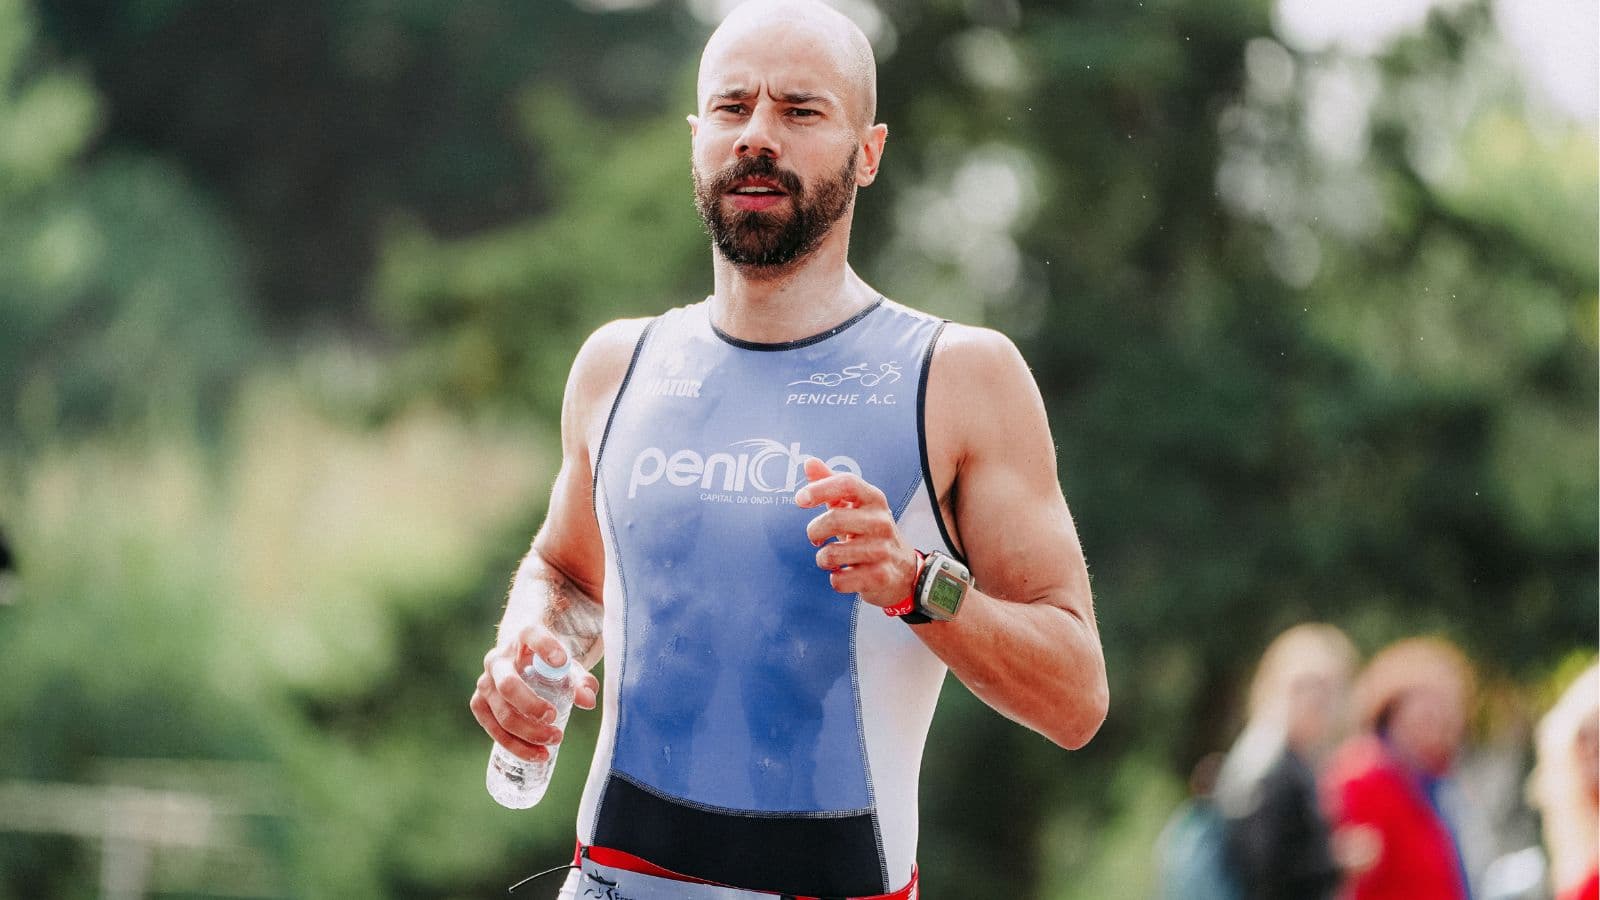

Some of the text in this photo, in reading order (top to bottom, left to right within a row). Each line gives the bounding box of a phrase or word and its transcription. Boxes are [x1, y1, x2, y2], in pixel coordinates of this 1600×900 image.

[786, 393, 897, 405] PENICHE A.C.
[700, 493, 734, 504] CAPITAL
[736, 496, 749, 504] DA
[750, 496, 774, 505] ONDA
